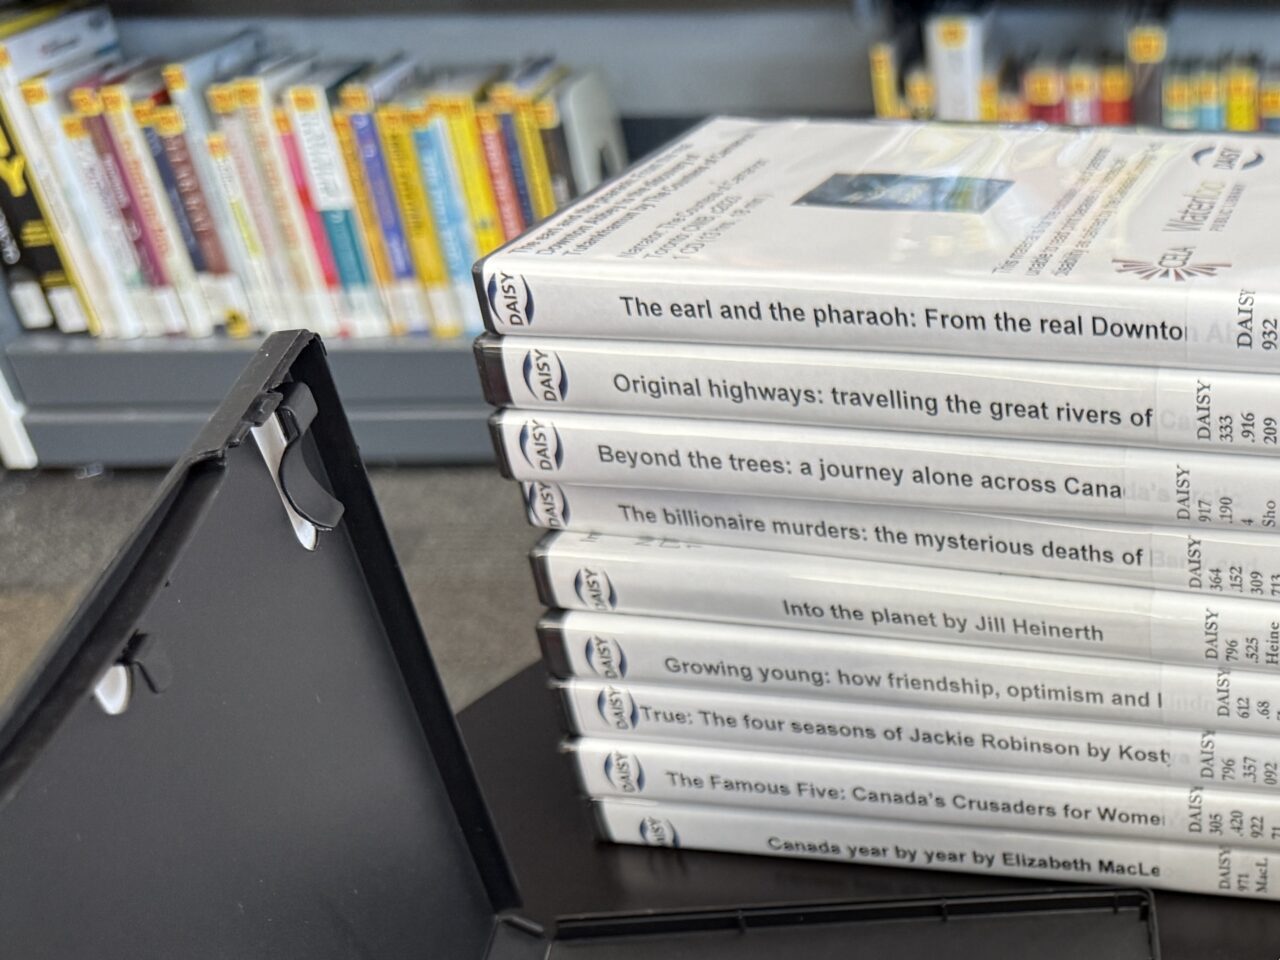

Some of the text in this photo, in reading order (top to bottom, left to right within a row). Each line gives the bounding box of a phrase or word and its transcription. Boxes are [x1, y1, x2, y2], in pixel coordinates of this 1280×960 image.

[501, 271, 525, 327] DAISY
[619, 296, 663, 319] The
[669, 299, 713, 320] earl
[720, 301, 762, 321] and
[769, 302, 807, 323] the
[813, 303, 917, 328] pharaoh:
[924, 308, 987, 333] From
[995, 312, 1033, 334] the
[1040, 315, 1084, 337] real
[1237, 288, 1257, 349] DAISY
[1261, 317, 1279, 351] 932
[534, 348, 558, 402] DAISY
[612, 373, 701, 399] Original
[708, 378, 823, 407] highways:
[830, 386, 938, 416] travelling
[945, 393, 981, 415] the
[989, 399, 1049, 422] great
[1056, 402, 1122, 426] rivers
[1129, 408, 1154, 428] of
[1196, 379, 1212, 441] DAISY
[531, 419, 555, 471] DAISY
[1220, 414, 1234, 443] 333
[1241, 411, 1255, 444] .916
[1263, 416, 1278, 445] 209
[597, 444, 681, 469] Beyond
[688, 449, 722, 470] the
[728, 453, 792, 475] trees:
[799, 460, 814, 476] a
[818, 457, 904, 486] journey
[911, 466, 974, 487] alone
[980, 471, 1057, 494] across
[1063, 476, 1126, 499] Cana
[1175, 464, 1191, 521] DAISY
[539, 482, 562, 528] DAISY
[1197, 498, 1213, 522] 917
[1219, 496, 1234, 524] .190
[1262, 499, 1277, 528] Sho
[617, 504, 657, 523] The
[662, 506, 766, 534] billionaire
[772, 520, 868, 541] murders:
[874, 525, 908, 545] the
[914, 531, 1034, 557] mysterious
[1041, 540, 1114, 563] deaths
[1121, 547, 1145, 566] of
[1187, 534, 1203, 589] DAISY
[1208, 567, 1222, 592] 364
[1250, 570, 1264, 596] 309
[584, 567, 609, 611] DAISY
[782, 599, 1104, 642] Into the planet by Jill Heinerth
[1204, 607, 1220, 661] DAISY
[595, 635, 618, 680] DAISY
[1225, 639, 1239, 662] 796
[1245, 636, 1260, 664] .525
[1265, 621, 1280, 666] Heine
[664, 656, 753, 681] Growing
[758, 667, 831, 688] young:
[837, 669, 881, 687] how
[887, 672, 1001, 700] friendship,
[1006, 681, 1104, 704] optimism
[1111, 691, 1151, 708] and
[1216, 667, 1232, 718] DAISY
[607, 685, 629, 730] DAISY
[1236, 697, 1250, 720] 612
[1257, 700, 1271, 720] .68
[639, 705, 693, 725] True:
[697, 709, 737, 727] The
[743, 713, 785, 732] four
[790, 719, 877, 740] seasons
[882, 725, 903, 742] of
[908, 726, 975, 748] Jackie
[981, 733, 1080, 757] Robinson
[1086, 741, 1111, 762] by
[1200, 728, 1216, 780] DAISY
[1221, 758, 1236, 782] 796
[1263, 761, 1278, 786] 092
[665, 771, 1166, 826] The Famous Five: Canada's Crusaders for Wome
[1188, 784, 1204, 834] DAISY
[1250, 815, 1265, 839] 922
[767, 836, 1160, 877] Canada year by year by Elizabeth MacLe
[1218, 845, 1232, 890] DAISY
